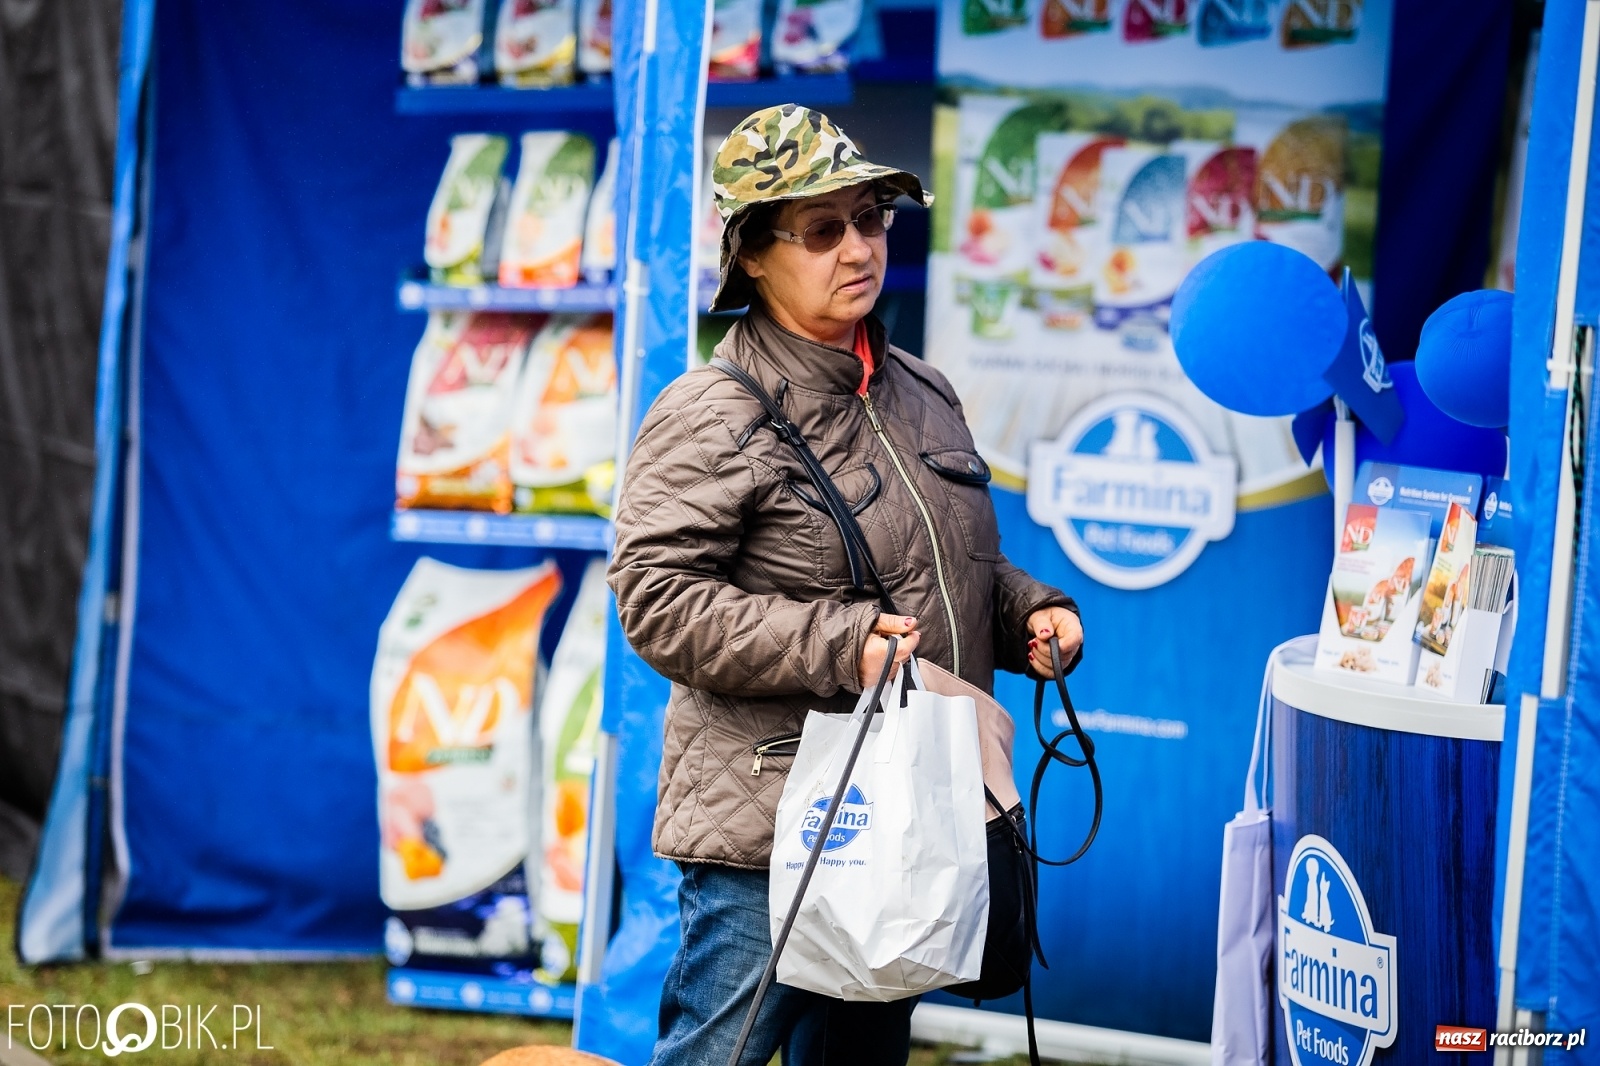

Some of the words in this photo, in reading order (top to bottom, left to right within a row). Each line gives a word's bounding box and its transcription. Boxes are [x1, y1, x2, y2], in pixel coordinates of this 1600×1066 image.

[1053, 465, 1212, 516] Farmina
[1346, 523, 1373, 545] ND
[801, 808, 868, 829] Faina
[786, 861, 805, 870] Happy
[820, 856, 846, 867] Happy
[1284, 926, 1378, 1019] Farmina
[1296, 1019, 1312, 1052] Pet
[1314, 1027, 1349, 1066] Foods
